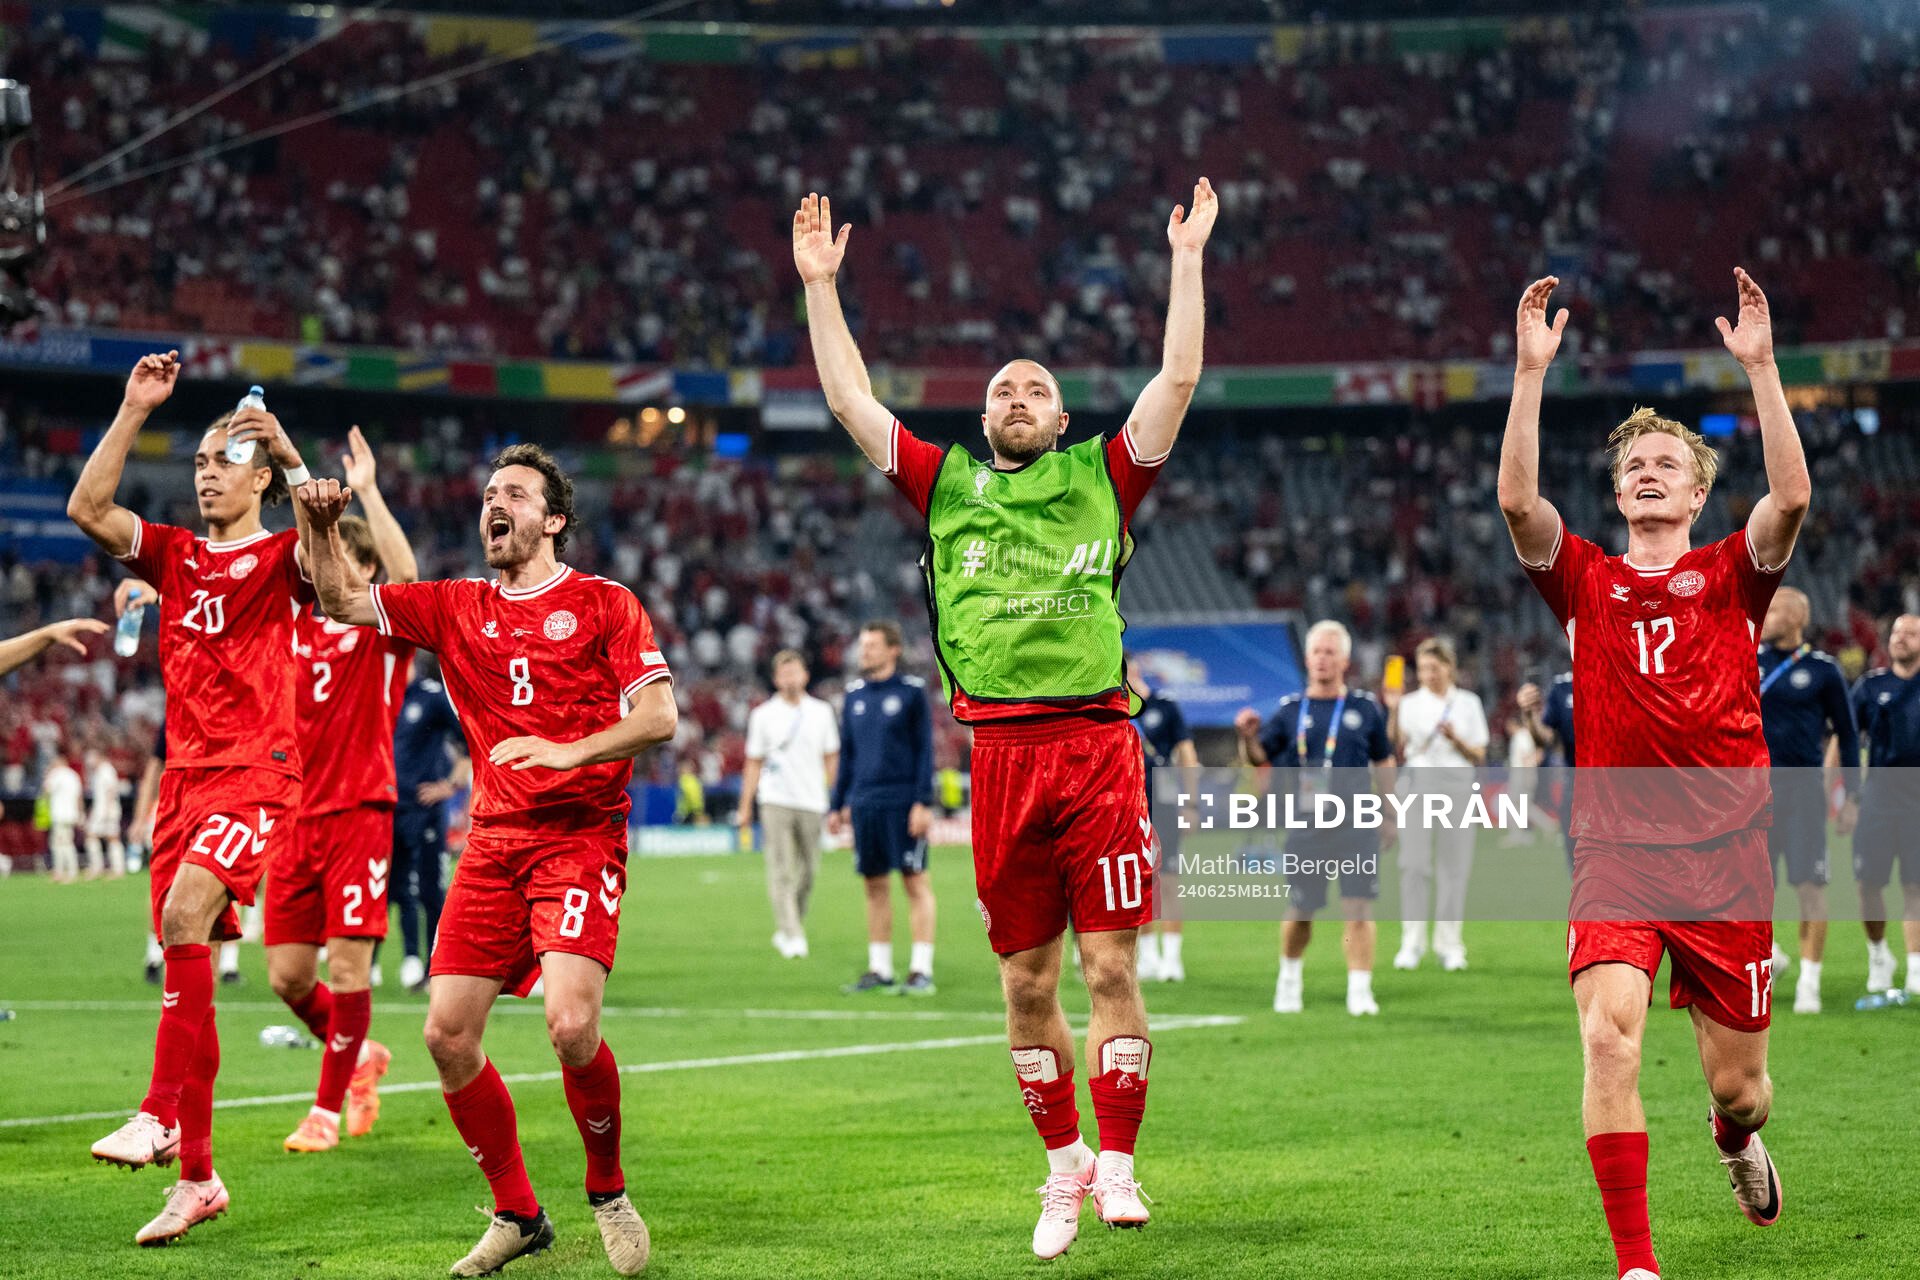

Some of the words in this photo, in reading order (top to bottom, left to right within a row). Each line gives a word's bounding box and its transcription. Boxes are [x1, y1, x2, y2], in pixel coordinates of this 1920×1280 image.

[182, 589, 226, 634] 20
[1006, 594, 1091, 614] RESPECT
[1631, 616, 1676, 674] 17
[312, 661, 331, 702] 2
[509, 657, 534, 705] 8
[191, 813, 252, 869] 20
[343, 885, 363, 926] 2
[1097, 853, 1142, 911] 10
[560, 887, 589, 938] 8
[1745, 958, 1773, 1018] 17
